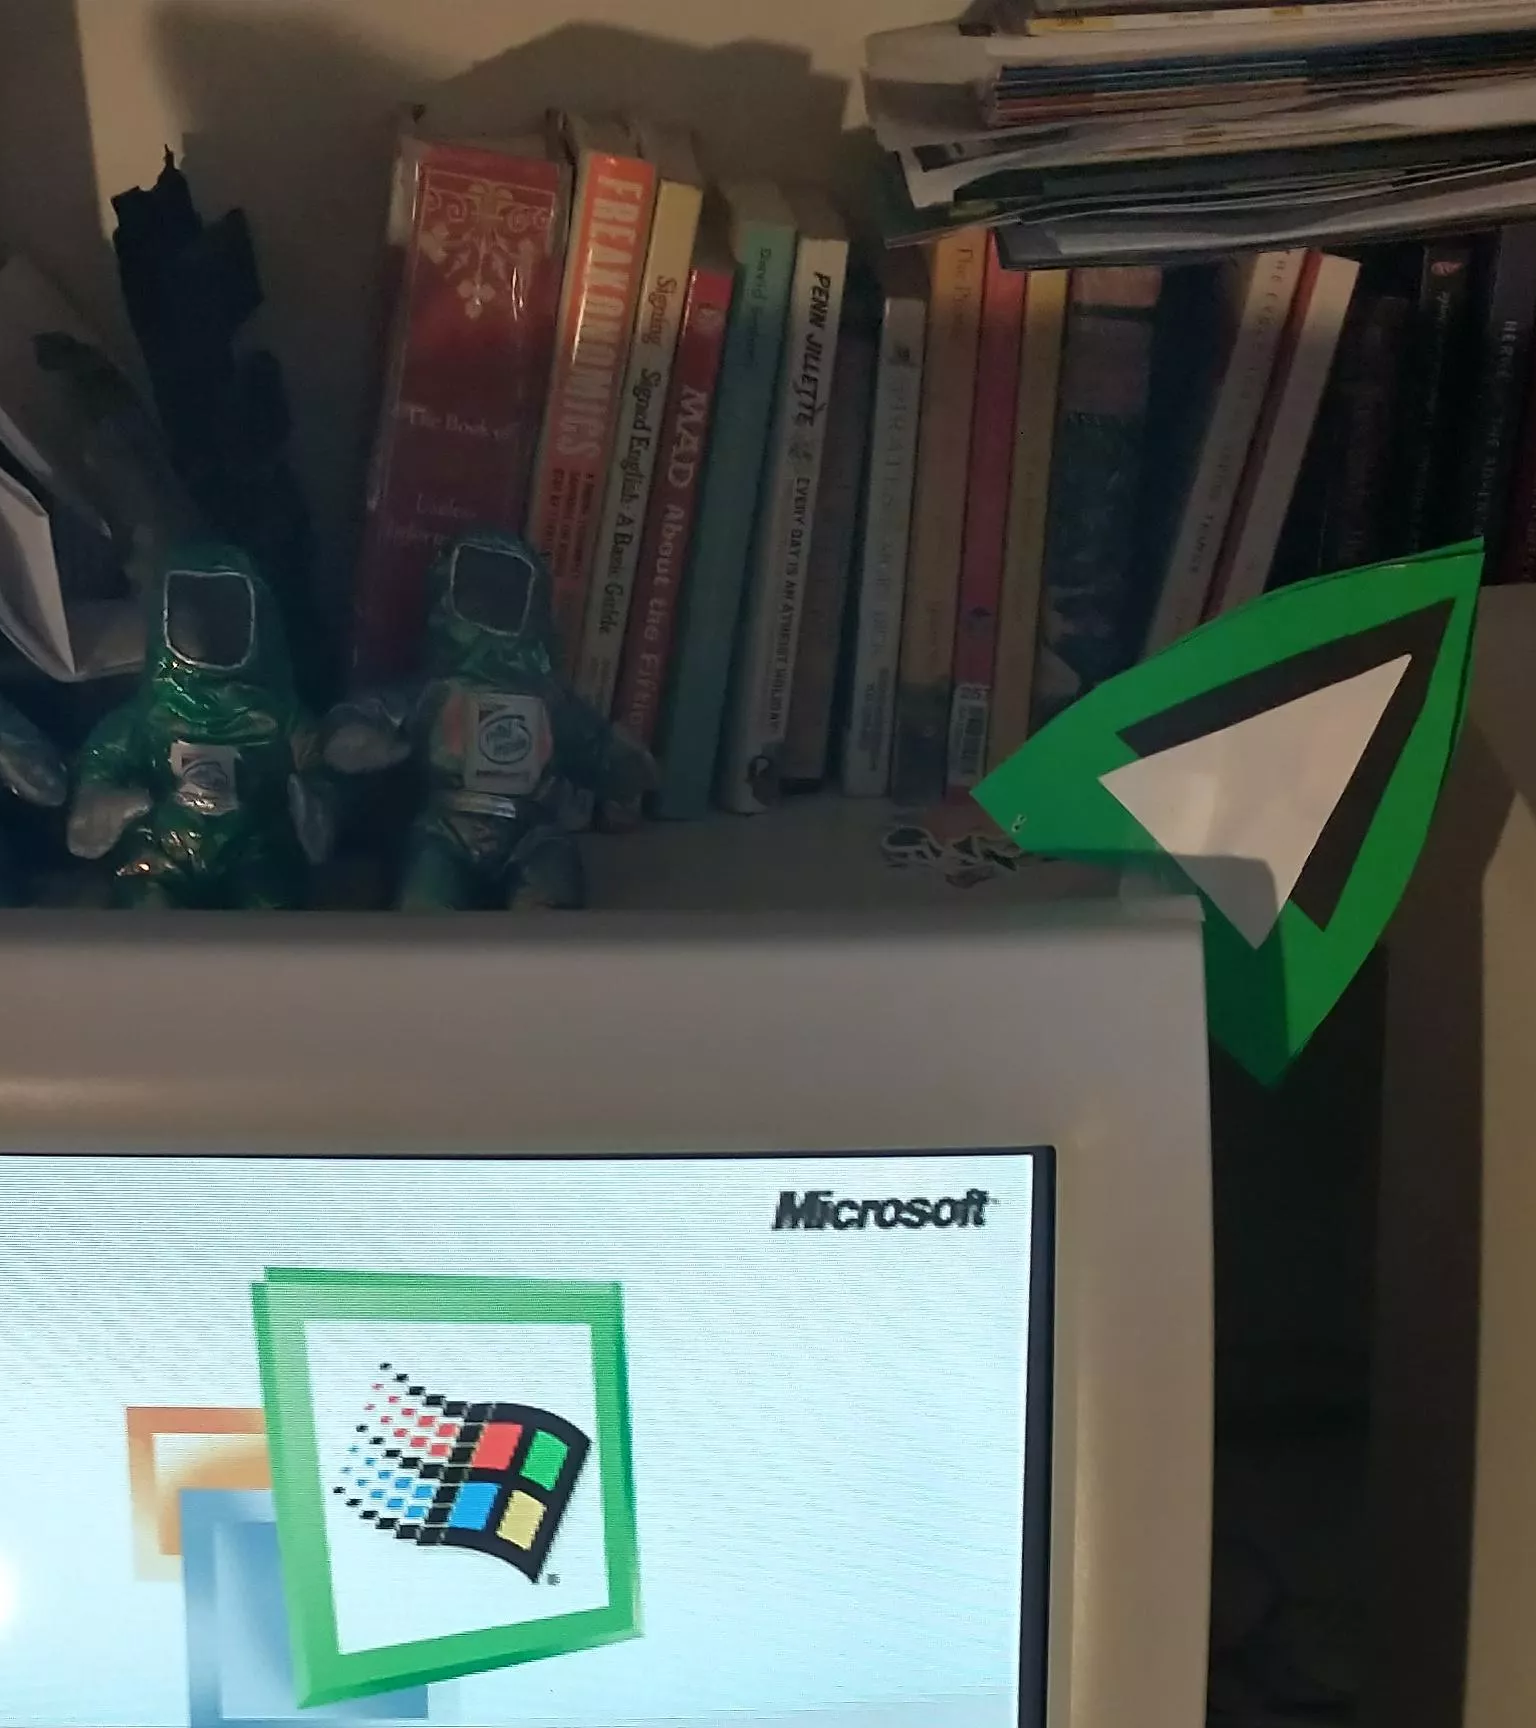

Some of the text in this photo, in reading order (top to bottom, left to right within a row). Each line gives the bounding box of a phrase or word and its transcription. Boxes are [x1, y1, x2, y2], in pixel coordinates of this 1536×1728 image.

[557, 175, 642, 457] FREAKONOMICS
[641, 275, 678, 345] Signing
[810, 271, 831, 331] PENN
[632, 368, 662, 432] Signed
[793, 333, 827, 427] JILLETTE
[667, 384, 709, 488] MAD
[652, 504, 686, 586] About
[643, 599, 669, 643] the
[771, 1188, 990, 1231] Microsoft
